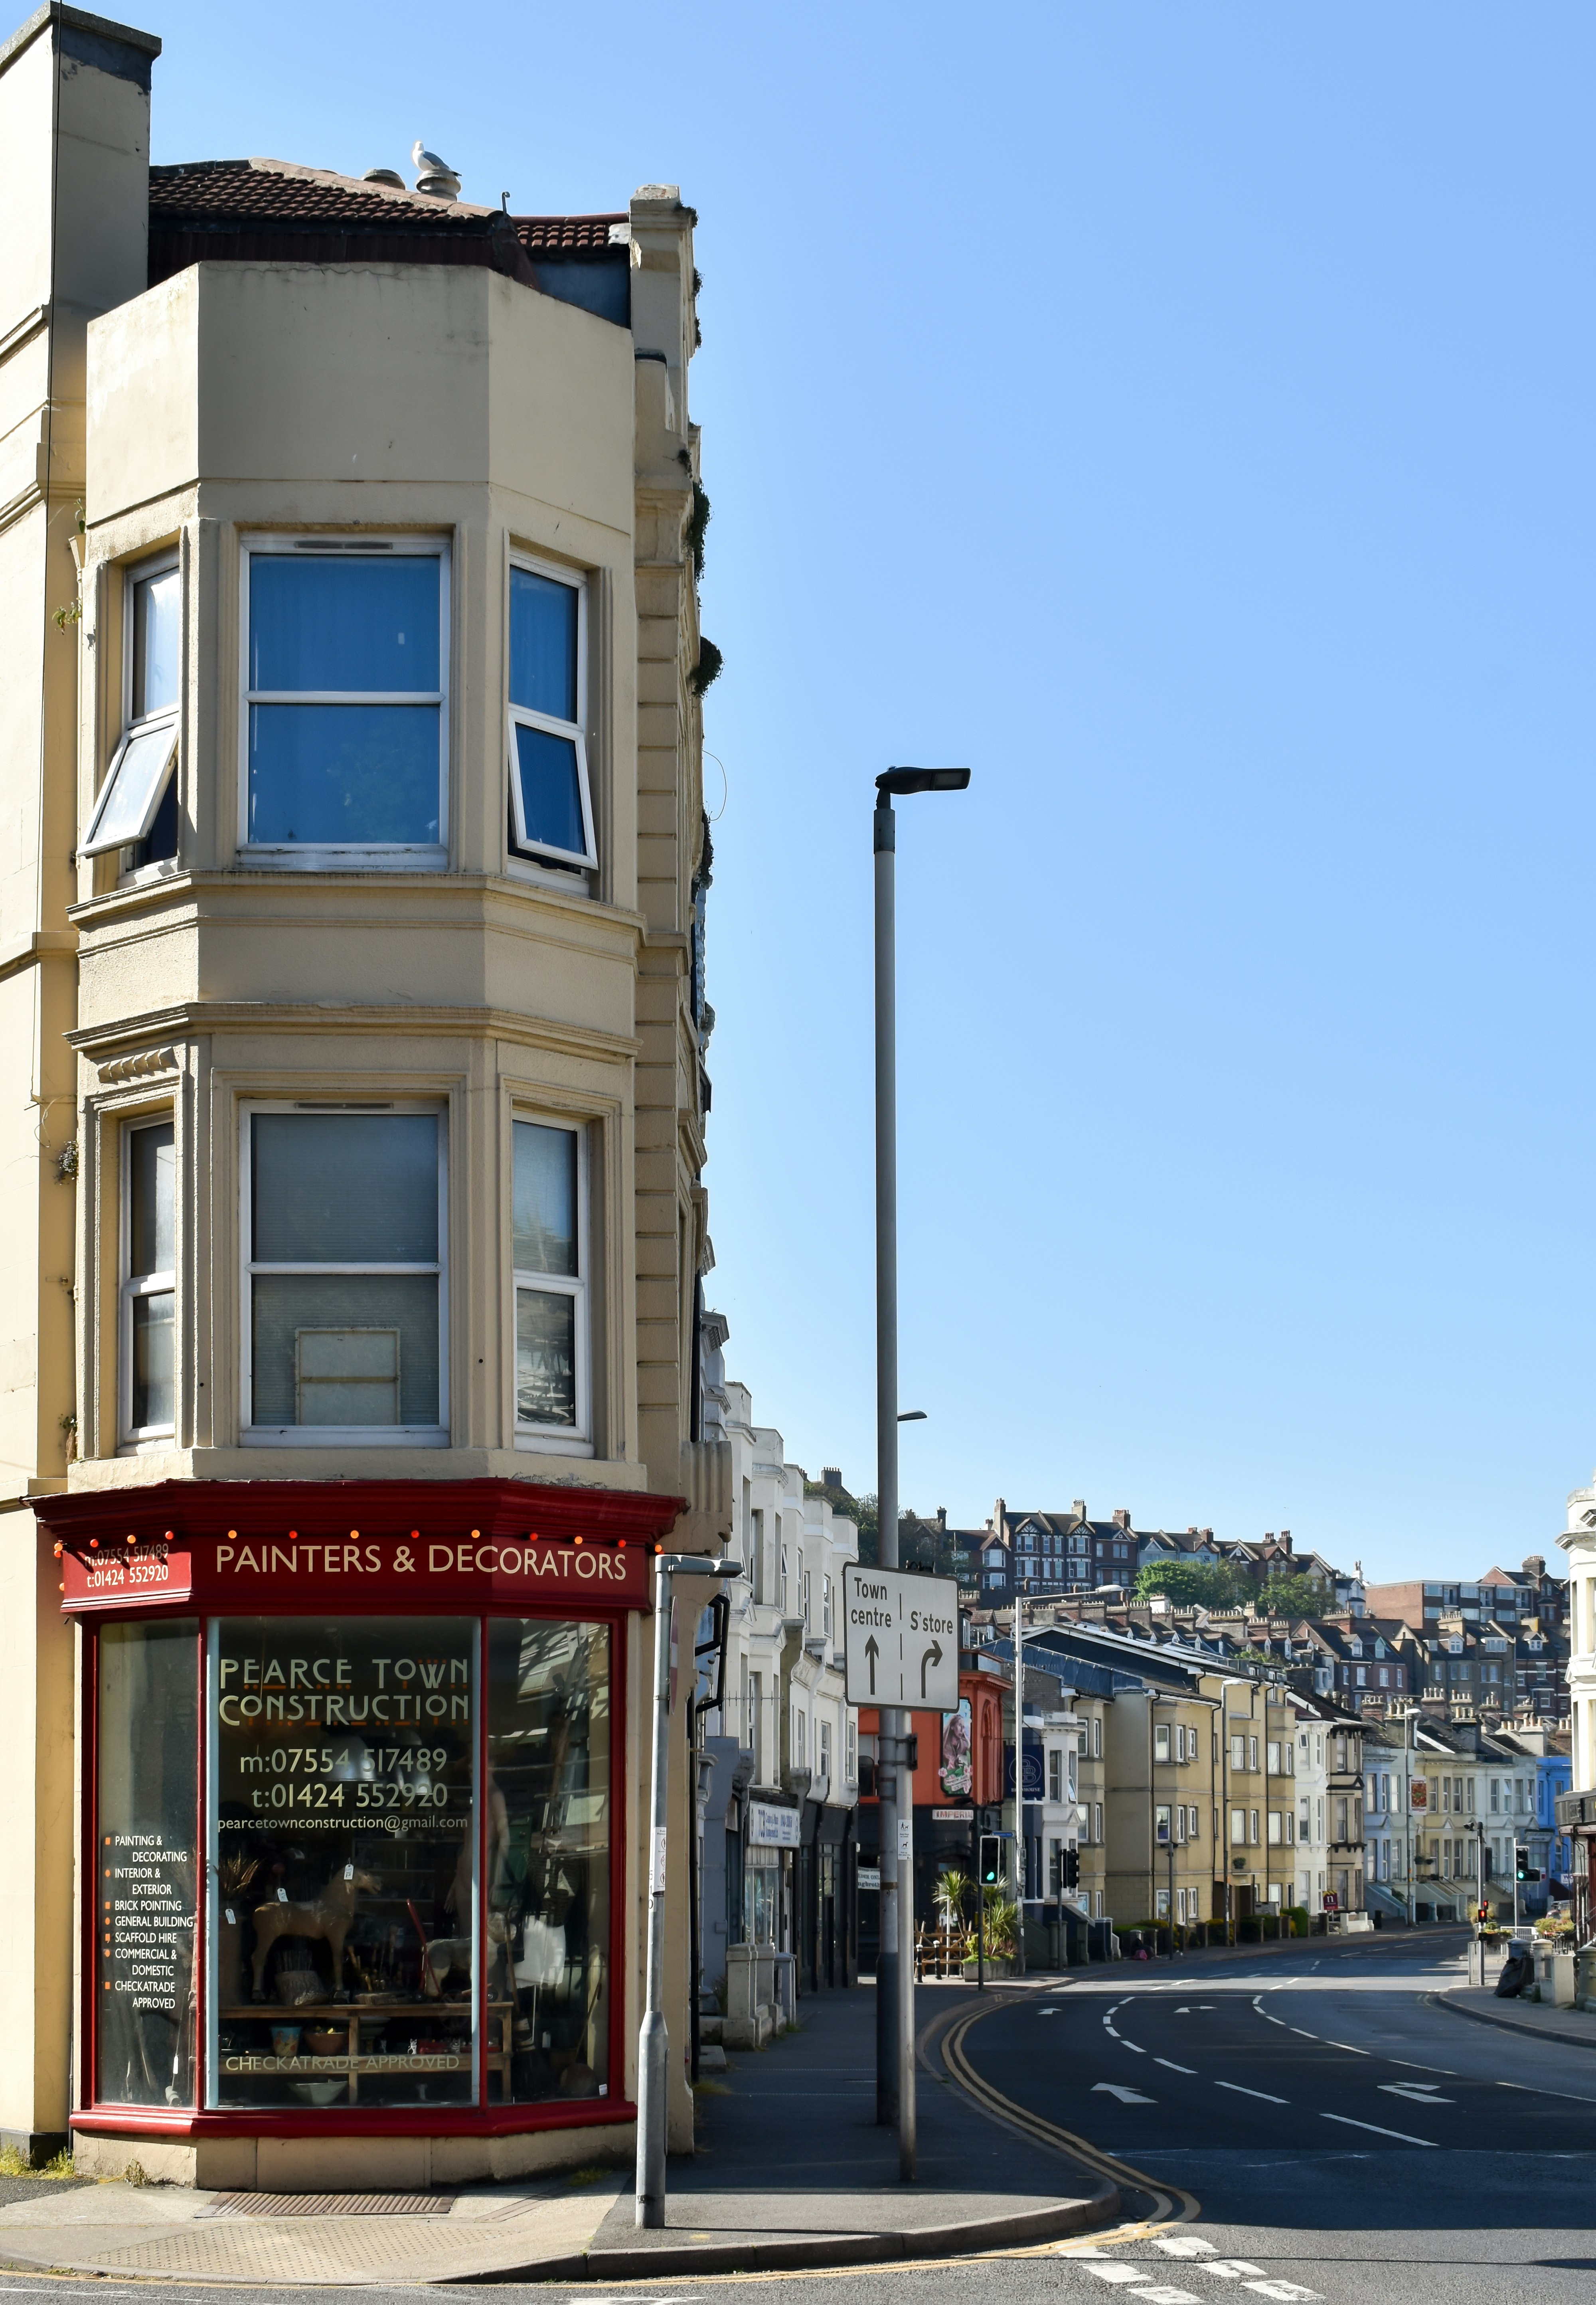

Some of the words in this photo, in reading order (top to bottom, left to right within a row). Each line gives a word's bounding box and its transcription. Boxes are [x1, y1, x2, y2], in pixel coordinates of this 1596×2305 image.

[85, 1548, 130, 1567] m:07554
[133, 1543, 169, 1563] 517489
[217, 1545, 381, 1573] PAINTERS
[393, 1545, 416, 1572] &
[429, 1545, 626, 1580] DECORATORS
[87, 1569, 124, 1588] t:01424
[129, 1565, 169, 1584] 552920
[854, 1577, 887, 1600] Town
[851, 1607, 892, 1628] centre
[910, 1610, 953, 1635] S'store
[220, 1659, 352, 1689] PEARCE
[372, 1658, 468, 1689] TOWN
[219, 1695, 469, 1726] CONSTRUCTION
[240, 1748, 350, 1773] m:07554
[362, 1748, 447, 1773] 517489
[251, 1783, 345, 1808] t:01424
[356, 1783, 448, 1807] 552920
[218, 1815, 468, 1833] pearcetownconstruction@gmail.com
[115, 1835, 154, 1847] PAINTING
[156, 1836, 162, 1845] &
[132, 1851, 187, 1863] DECORATING
[115, 1868, 153, 1878] INTERIOR
[155, 1868, 161, 1878] &
[132, 1884, 172, 1895] EXTERIOR
[115, 1900, 138, 1911] BRICK
[141, 1900, 182, 1912] POINTING
[115, 1916, 152, 1927] GENERAL
[154, 1916, 194, 1928] BUILDING
[115, 1932, 156, 1943] SCAFFOLD
[159, 1933, 177, 1944] HIRE
[115, 1948, 169, 1960] COMMERCIAL
[171, 1949, 177, 1960] &
[132, 1965, 174, 1976] DOMESTIC
[115, 1981, 175, 1993] CHECKATRADE
[132, 1997, 175, 2009] APPROVED
[225, 2056, 359, 2071] CHECKATRADE
[366, 2055, 460, 2070] APPROVED
